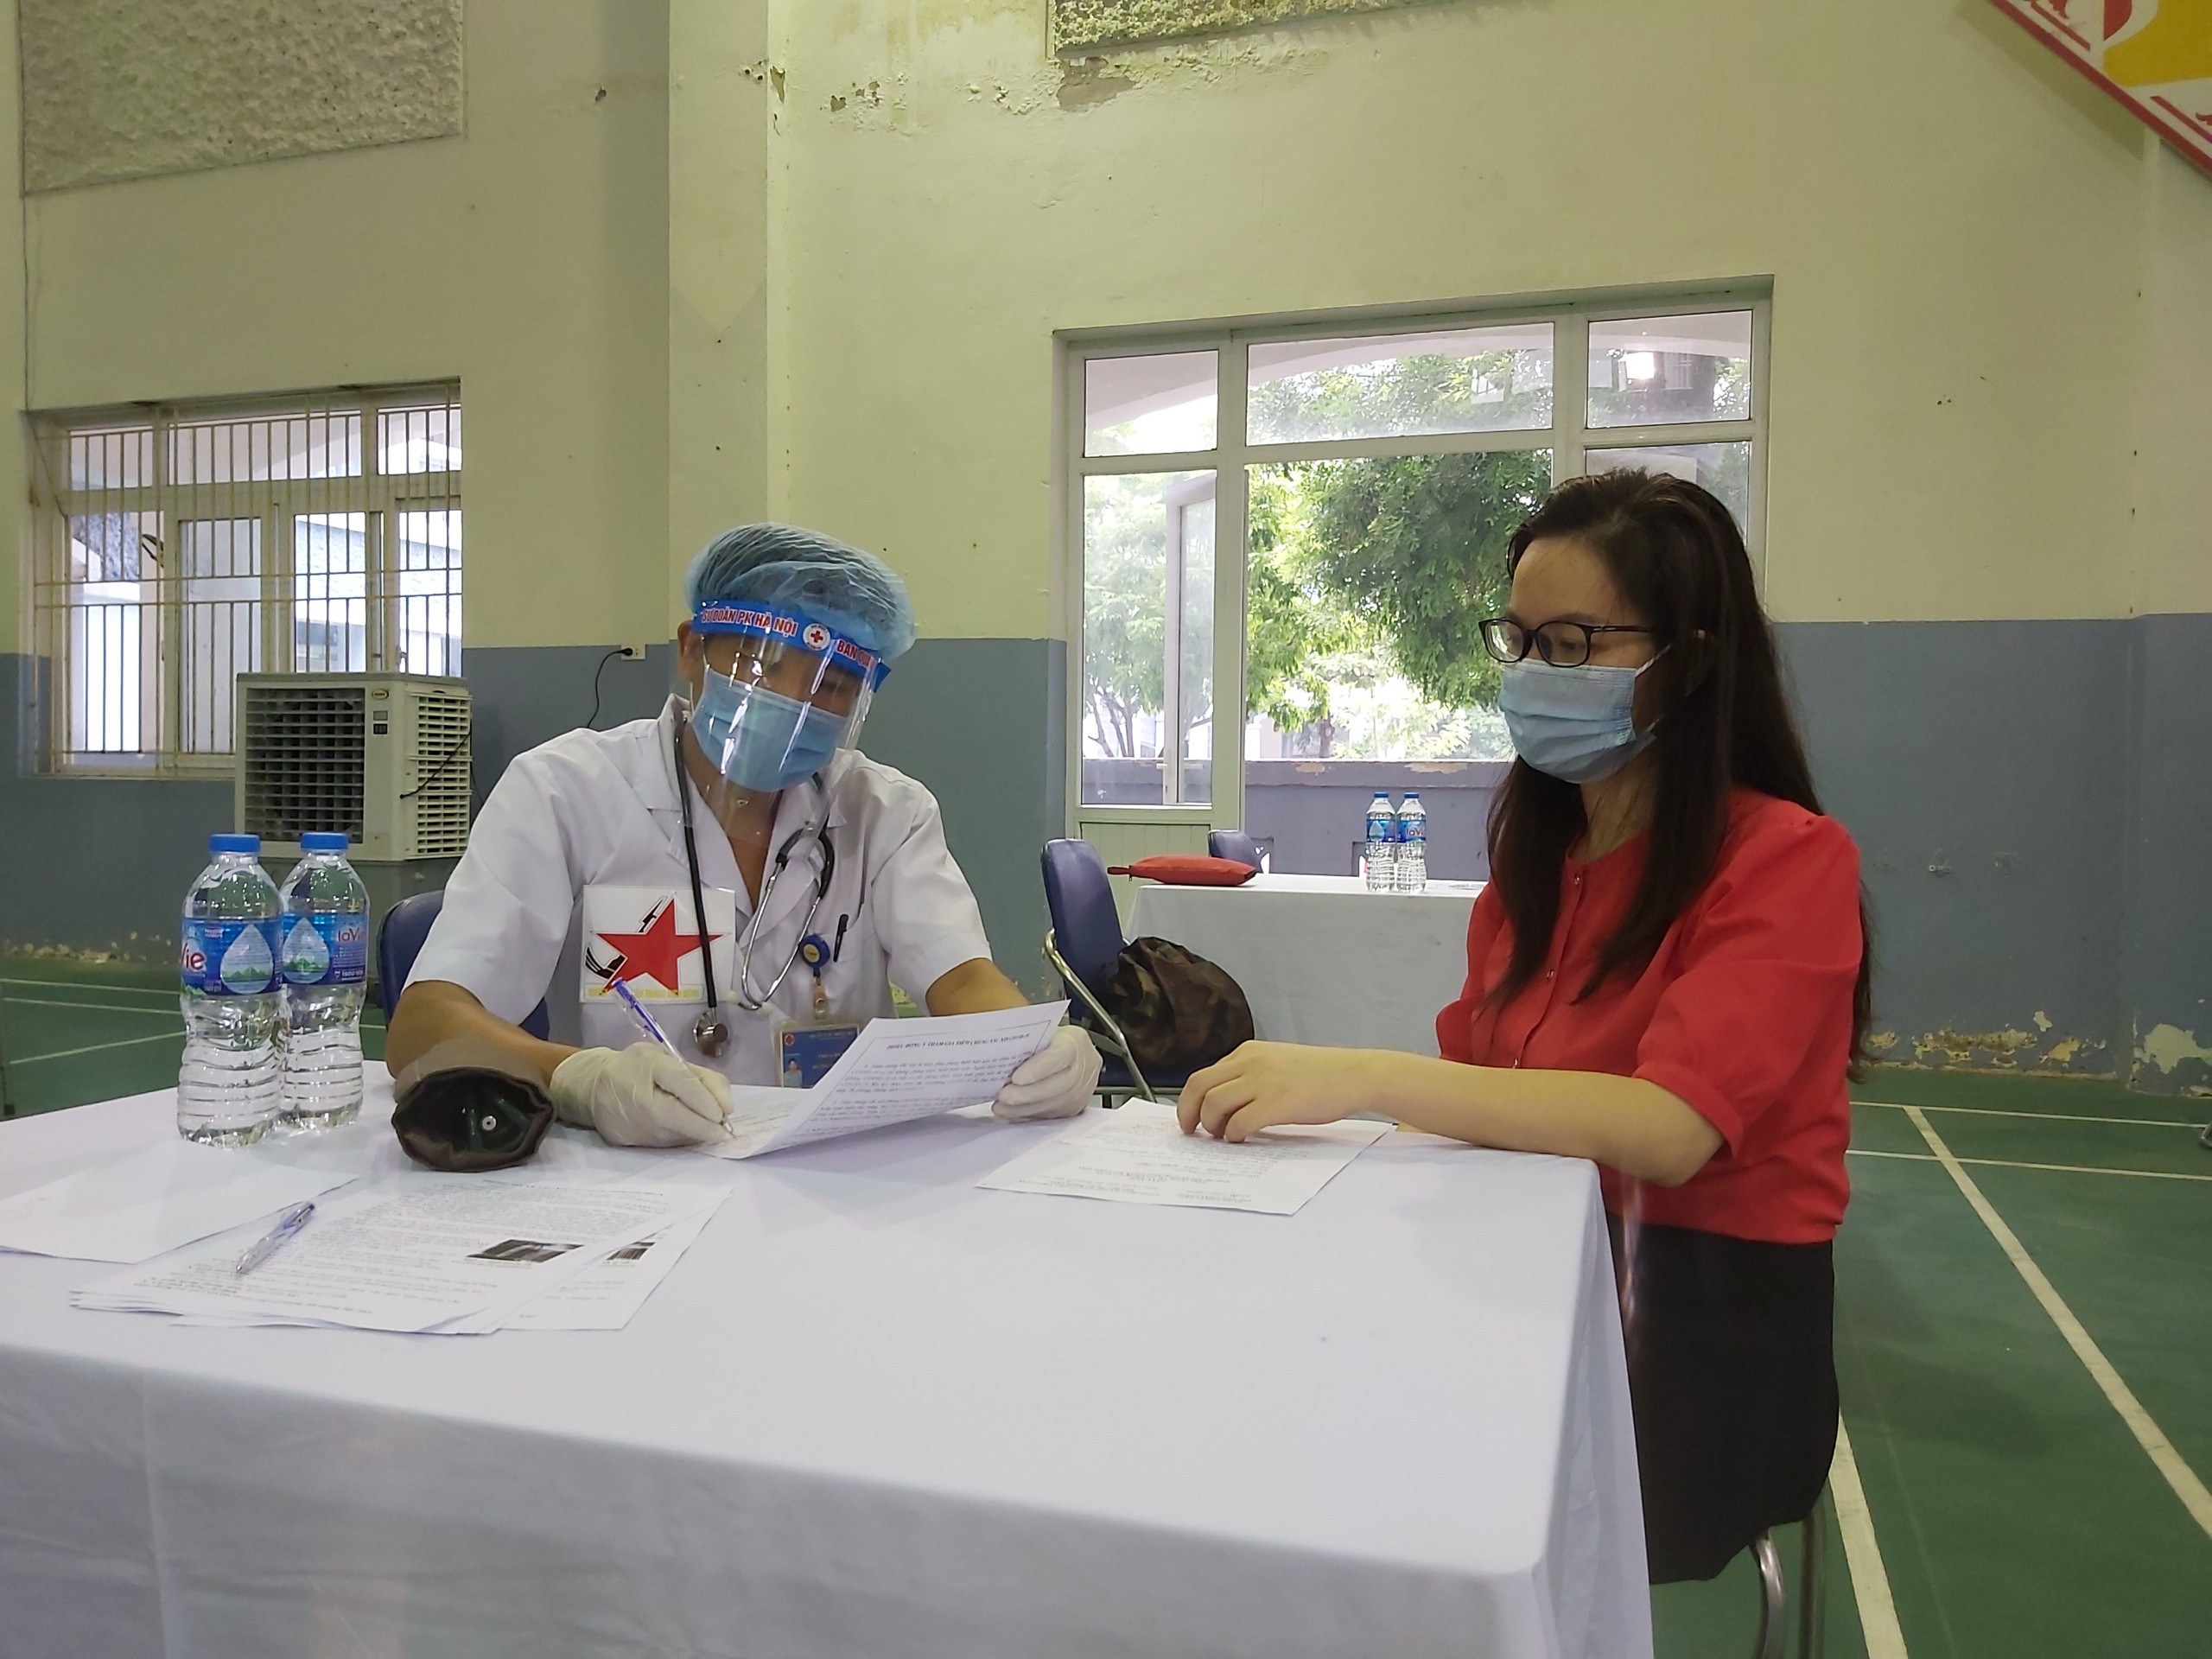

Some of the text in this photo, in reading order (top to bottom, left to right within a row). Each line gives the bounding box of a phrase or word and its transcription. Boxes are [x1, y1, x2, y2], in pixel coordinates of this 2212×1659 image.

[736, 610, 753, 626] PK
[753, 612, 772, 628] HÀ
[773, 617, 798, 637] NỘI
[837, 639, 858, 660] BAN
